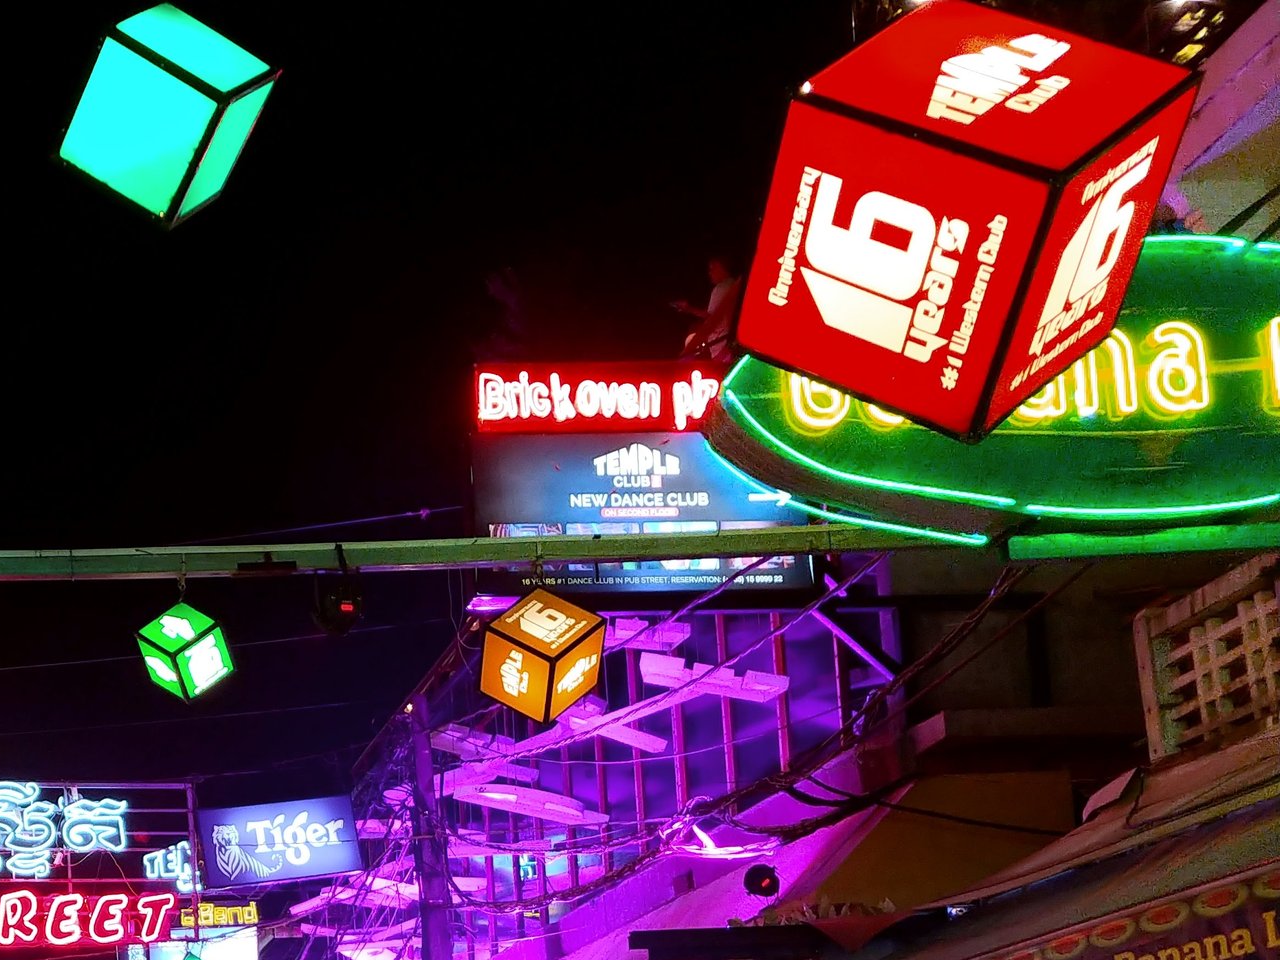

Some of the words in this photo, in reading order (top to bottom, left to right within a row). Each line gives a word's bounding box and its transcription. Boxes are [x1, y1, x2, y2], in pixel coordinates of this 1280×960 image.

[768, 166, 822, 307] Anniversary
[977, 214, 1008, 265] Club
[1037, 154, 1153, 330] 16
[800, 172, 936, 354] 16
[948, 263, 995, 355] Western
[478, 370, 576, 422] Brick
[575, 380, 661, 420] oven
[940, 354, 963, 390] #1
[593, 443, 680, 477] TEMPLE
[613, 475, 650, 488] CLUB
[569, 493, 608, 507] NEW
[610, 492, 664, 507] DANCE
[666, 492, 709, 506] CLUB
[567, 577, 593, 585] DANCE
[625, 576, 640, 584] PUB
[519, 602, 567, 641] 16
[246, 810, 345, 866] Tiger
